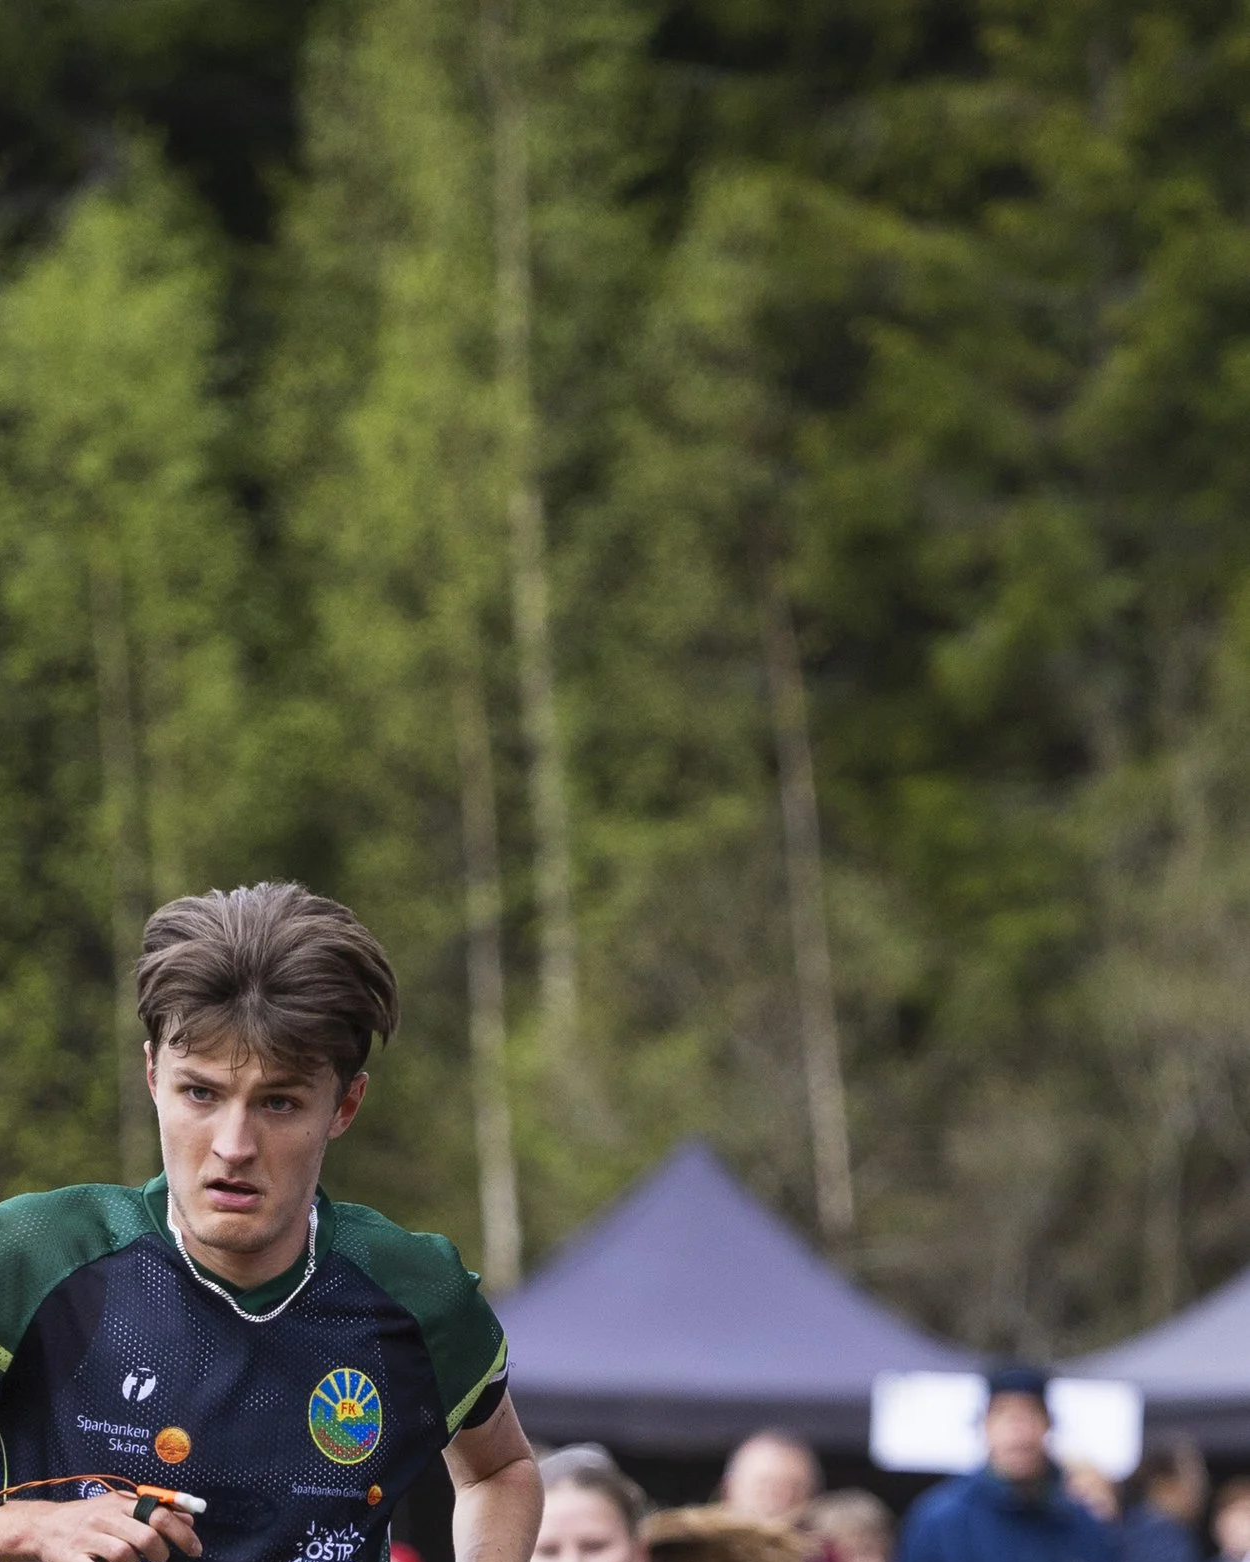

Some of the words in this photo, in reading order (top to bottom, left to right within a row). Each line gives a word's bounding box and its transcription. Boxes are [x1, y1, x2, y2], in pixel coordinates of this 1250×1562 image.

[340, 1402, 357, 1416] FK
[76, 1414, 150, 1439] Sparbanken
[108, 1437, 148, 1455] Skåne
[291, 1481, 342, 1497] Sparbanken
